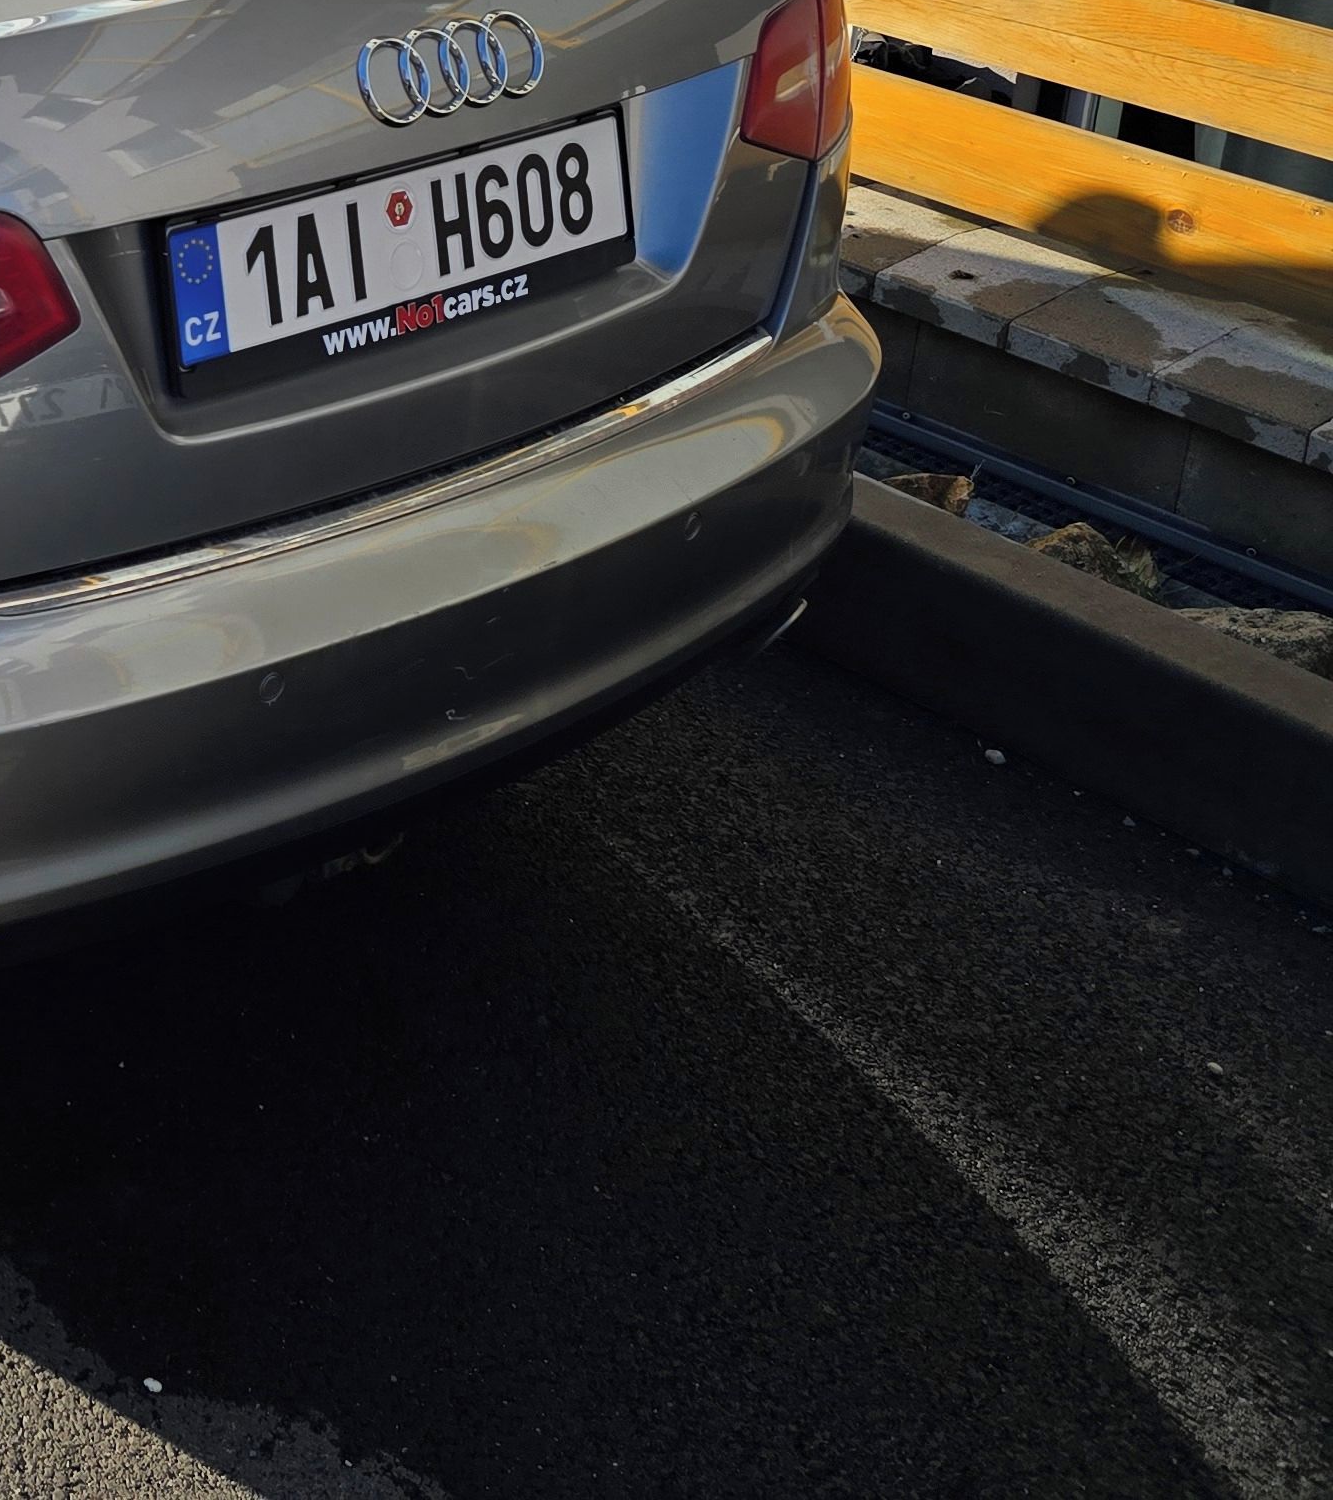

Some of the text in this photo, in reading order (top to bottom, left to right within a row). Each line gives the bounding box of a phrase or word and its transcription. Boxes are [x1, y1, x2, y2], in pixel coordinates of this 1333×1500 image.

[246, 142, 593, 327] 1AI H608
[184, 311, 221, 346] CZ
[323, 274, 529, 356] www.No1cars.cz
